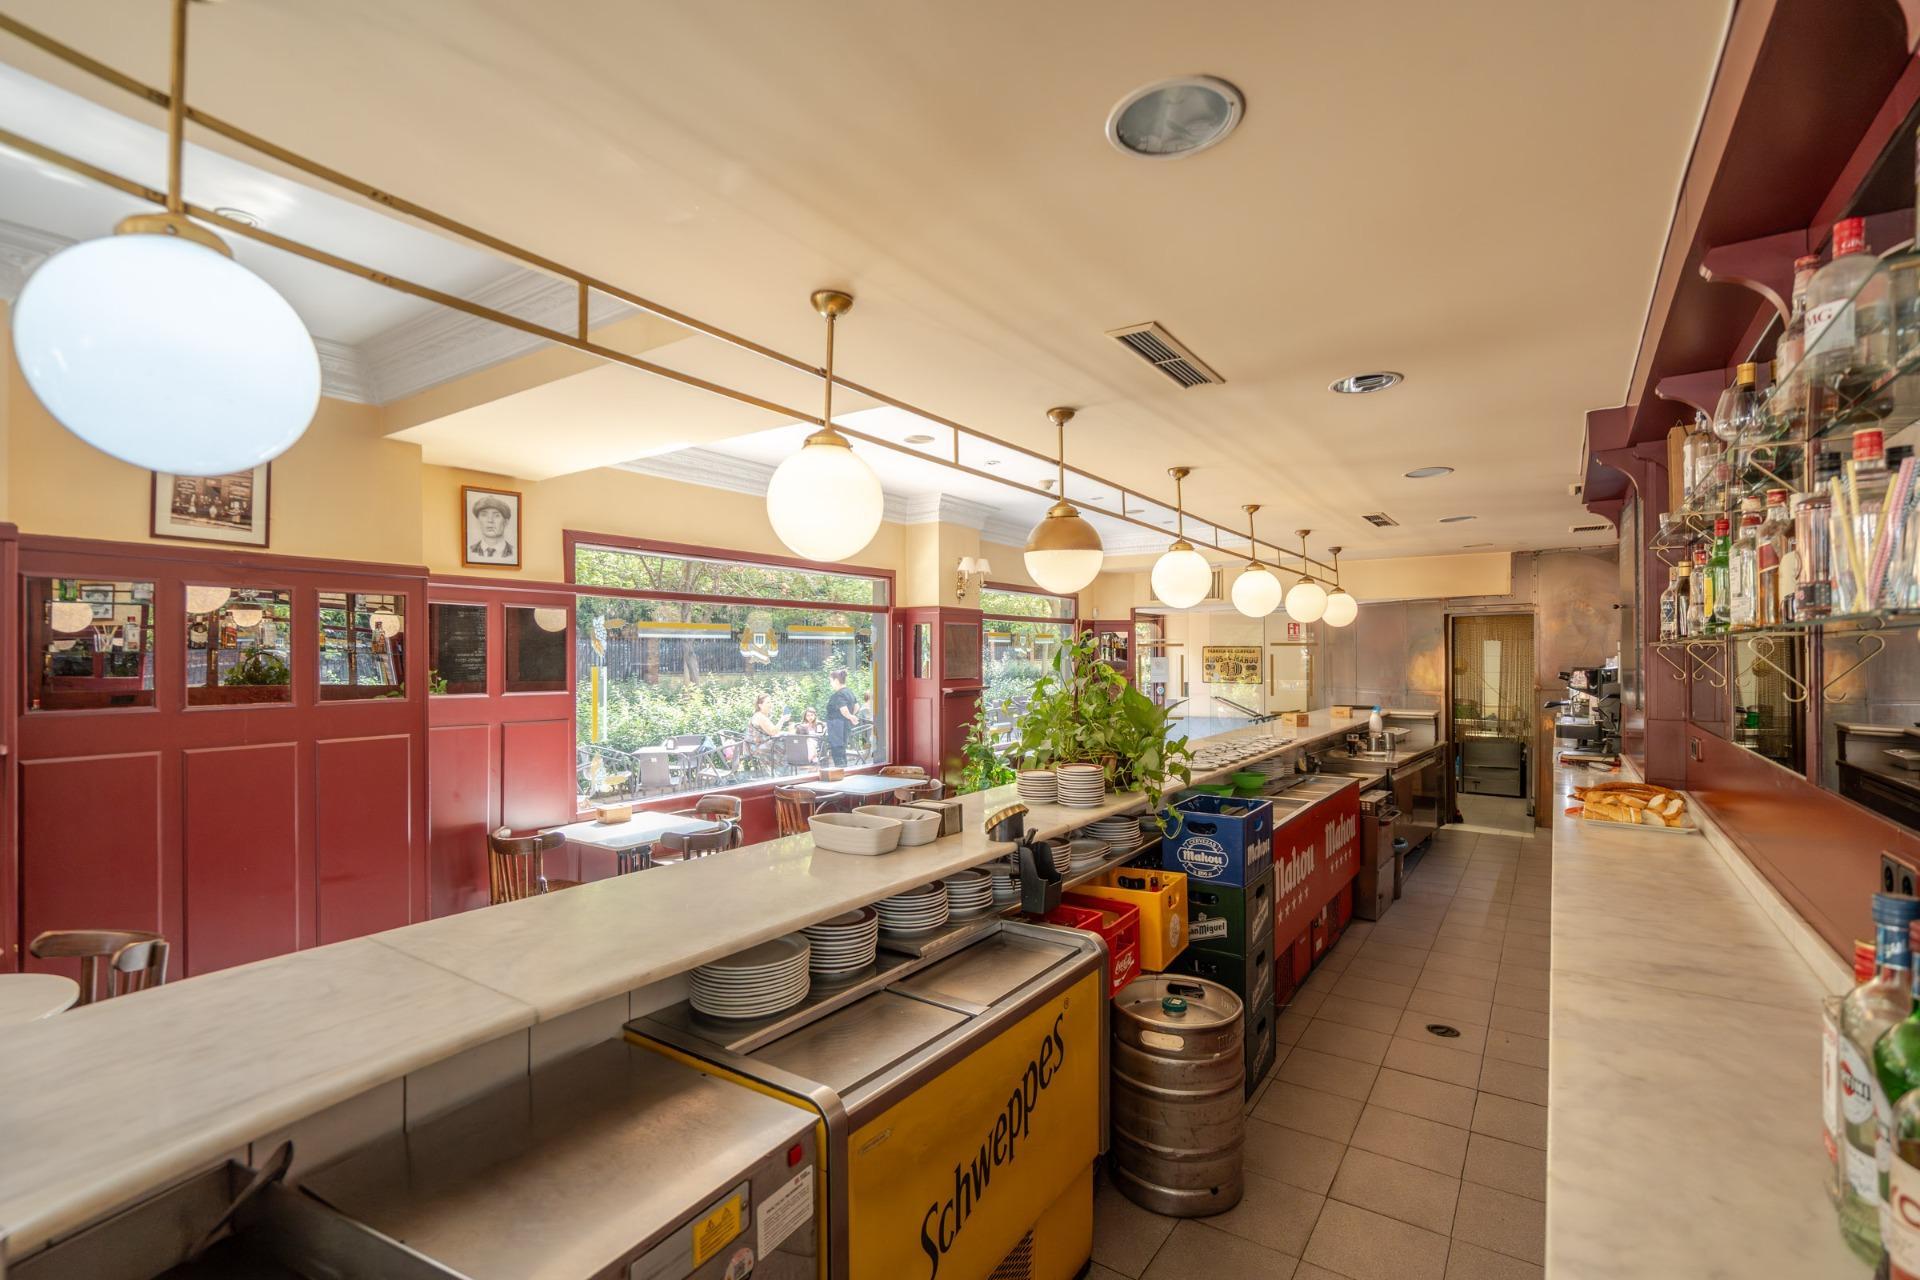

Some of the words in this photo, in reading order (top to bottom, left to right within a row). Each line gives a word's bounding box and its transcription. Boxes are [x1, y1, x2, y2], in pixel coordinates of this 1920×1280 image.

[1325, 812, 1356, 859] Mahou
[1182, 849, 1223, 865] Mahou
[1247, 838, 1270, 867] Mahou
[1188, 926, 1199, 935] an
[1199, 922, 1225, 935] Miguel
[920, 1012, 1064, 1280] Schweppes
